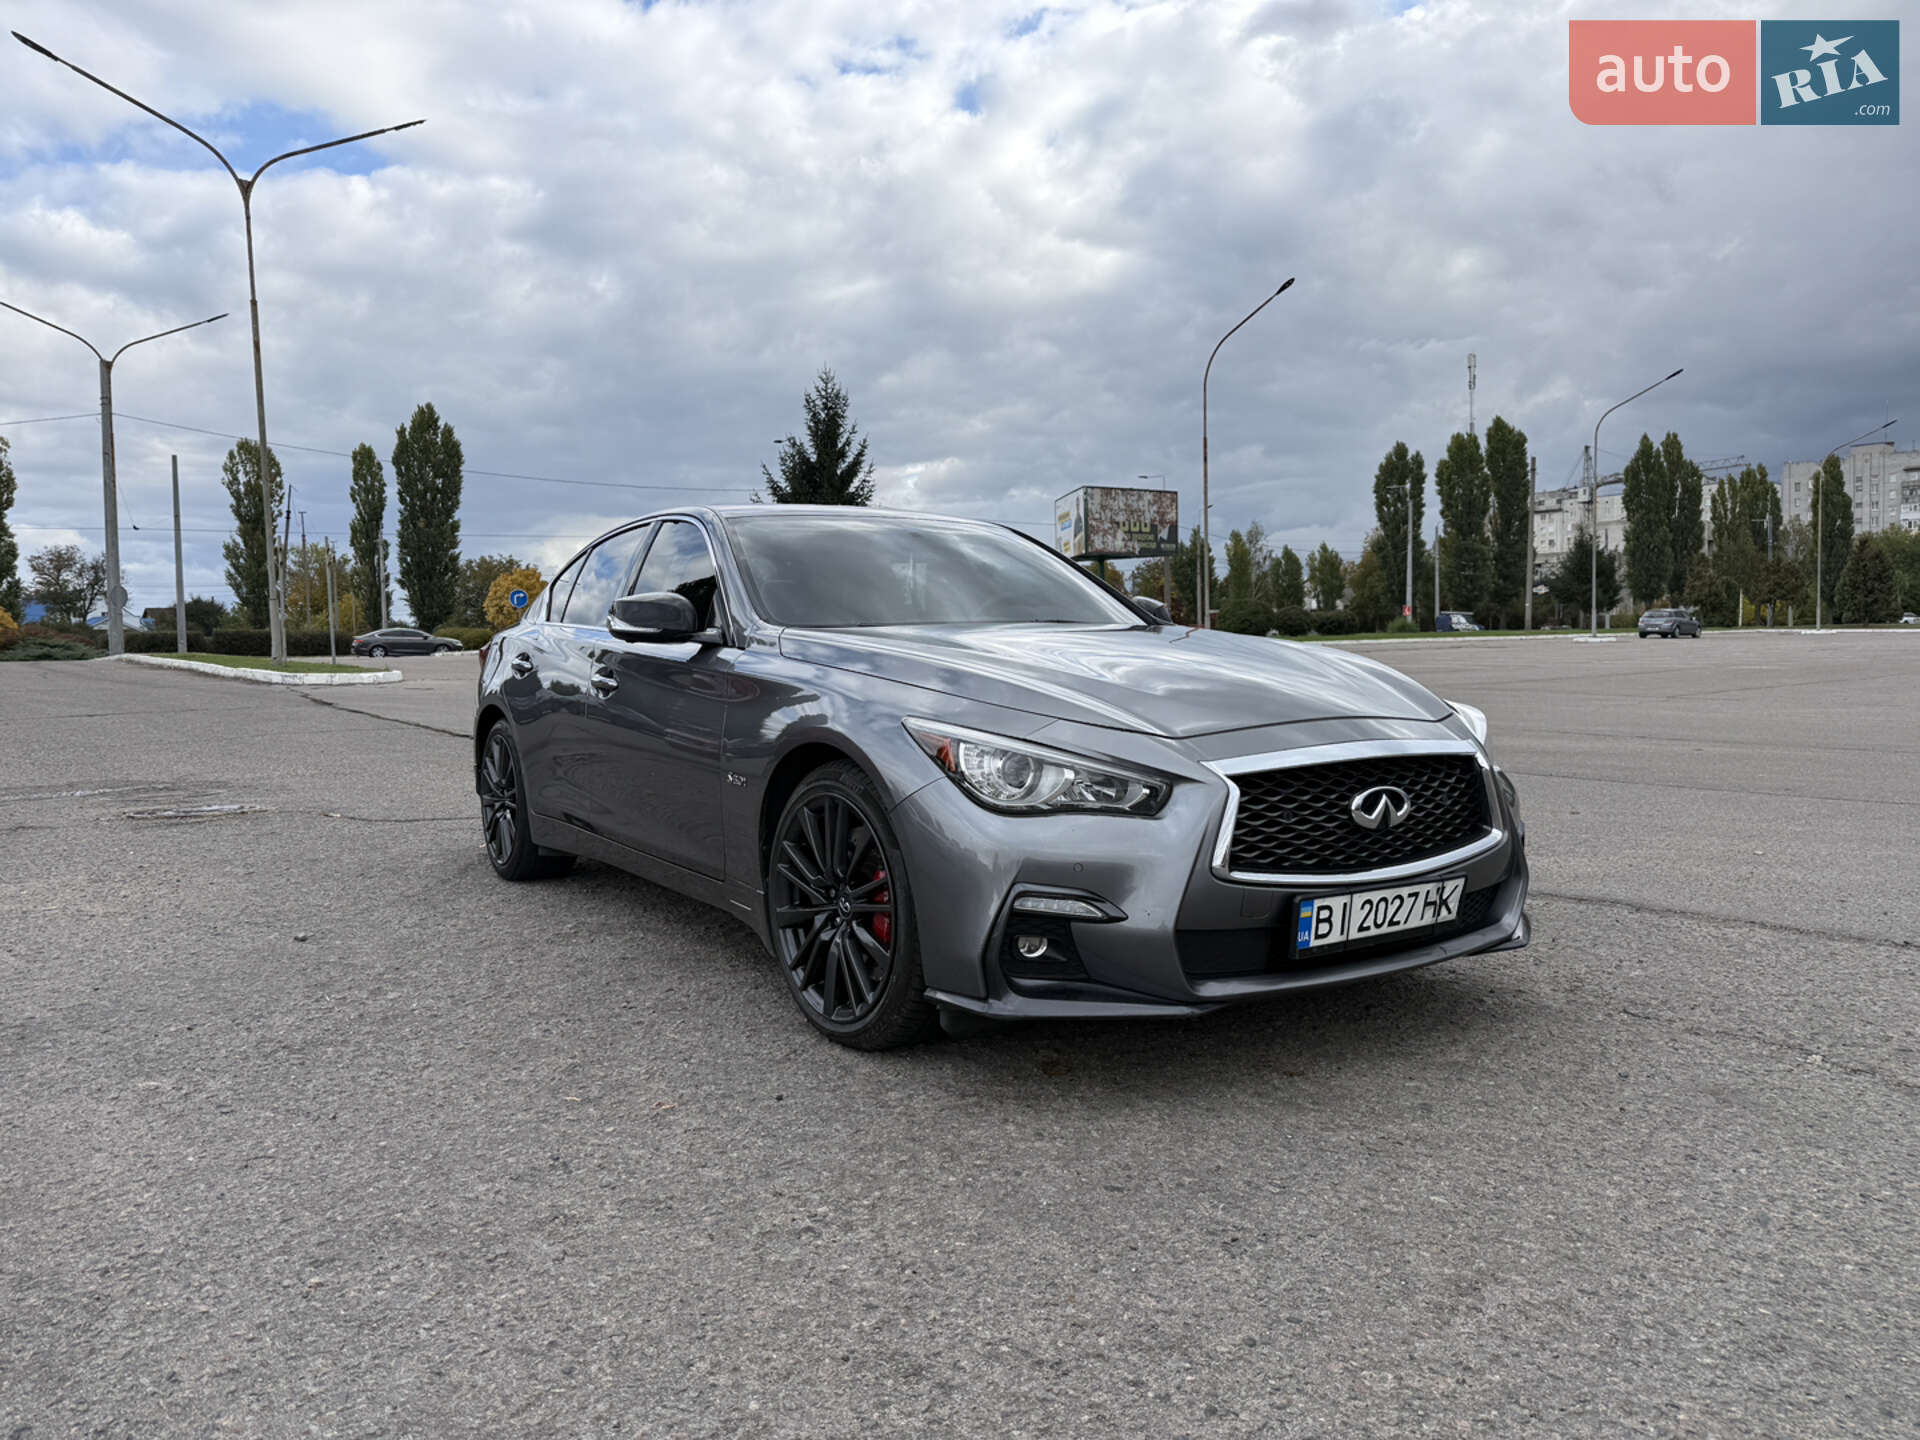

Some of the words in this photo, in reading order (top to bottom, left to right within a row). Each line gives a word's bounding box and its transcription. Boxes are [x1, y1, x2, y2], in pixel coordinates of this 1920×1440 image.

[1314, 902, 1347, 940] BI
[1358, 892, 1419, 932] 2027
[1420, 884, 1459, 920] HK
[1297, 931, 1310, 942] UA
